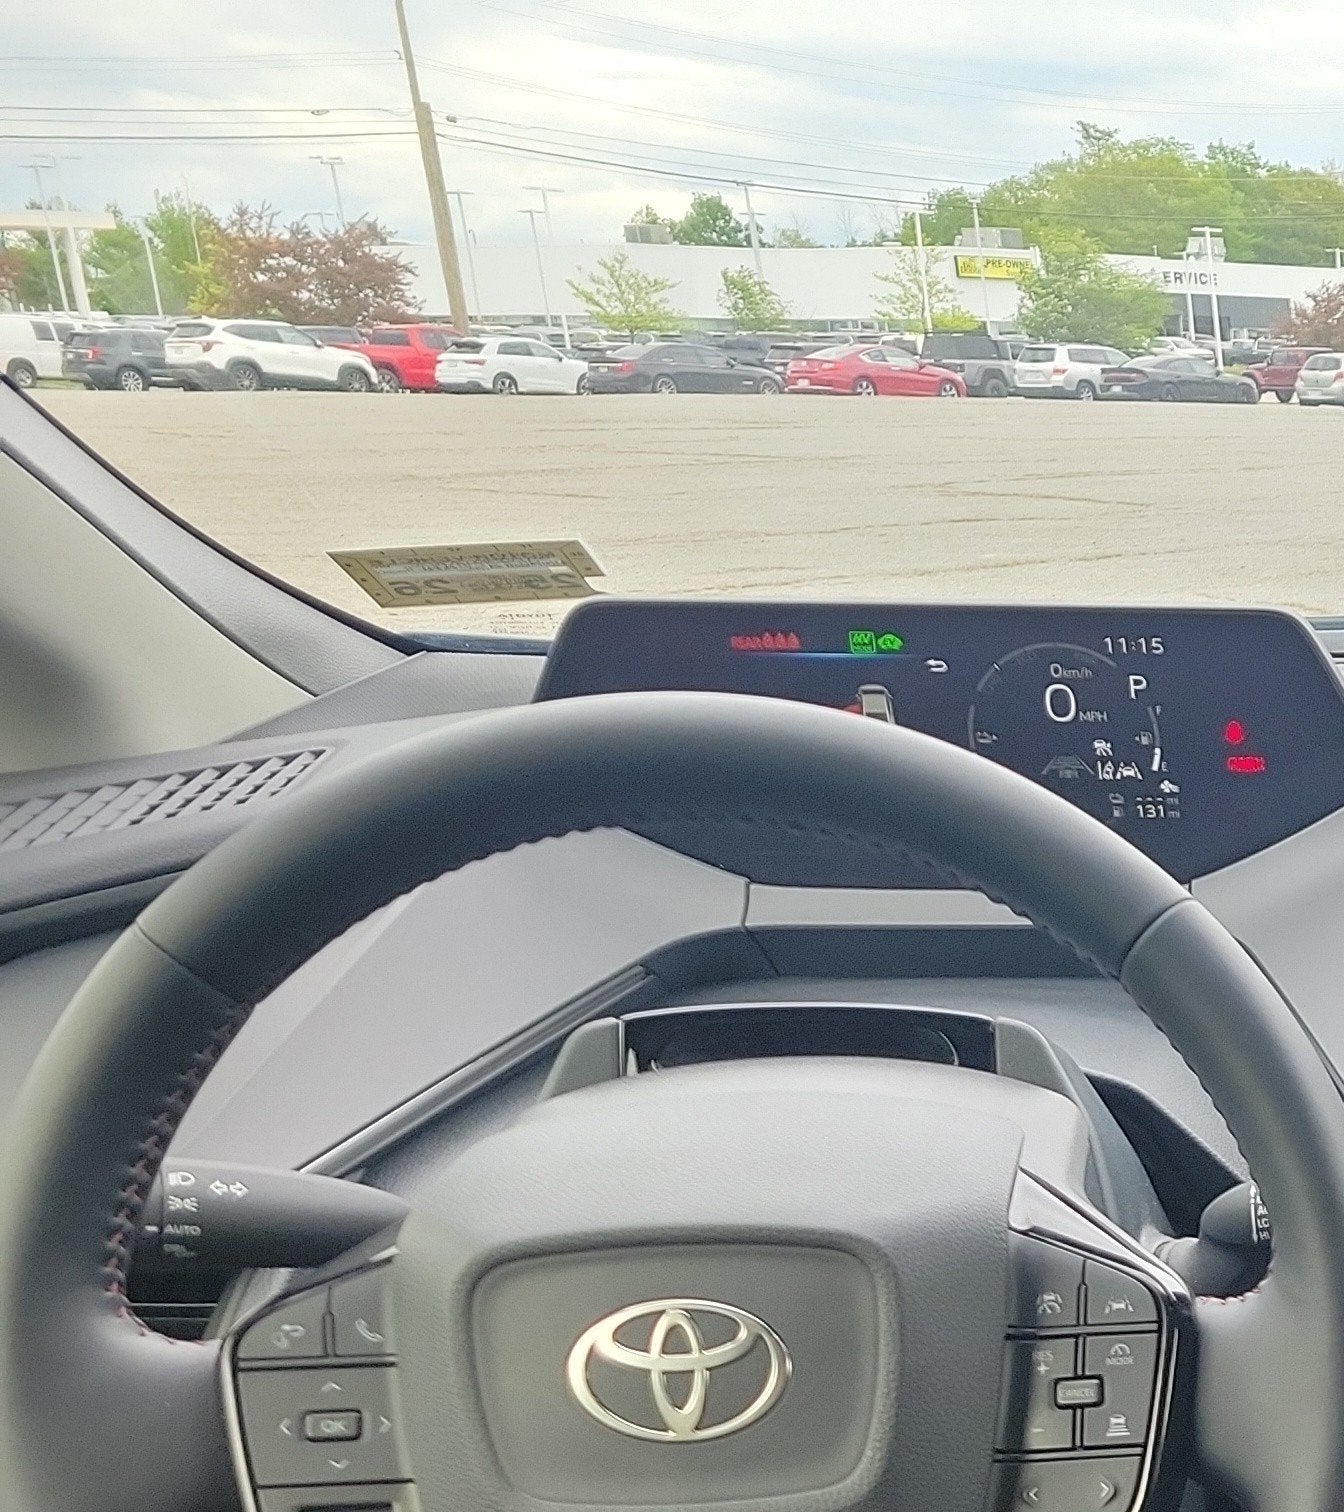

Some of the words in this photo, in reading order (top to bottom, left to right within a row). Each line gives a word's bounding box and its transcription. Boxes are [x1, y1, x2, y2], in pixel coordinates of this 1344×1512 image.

[1161, 270, 1218, 286] ERVICE
[1103, 636, 1165, 655] 11:15
[1128, 675, 1147, 700] P
[1079, 711, 1108, 723] MPH
[1136, 804, 1165, 818] 131
[163, 1223, 202, 1237] AUTO
